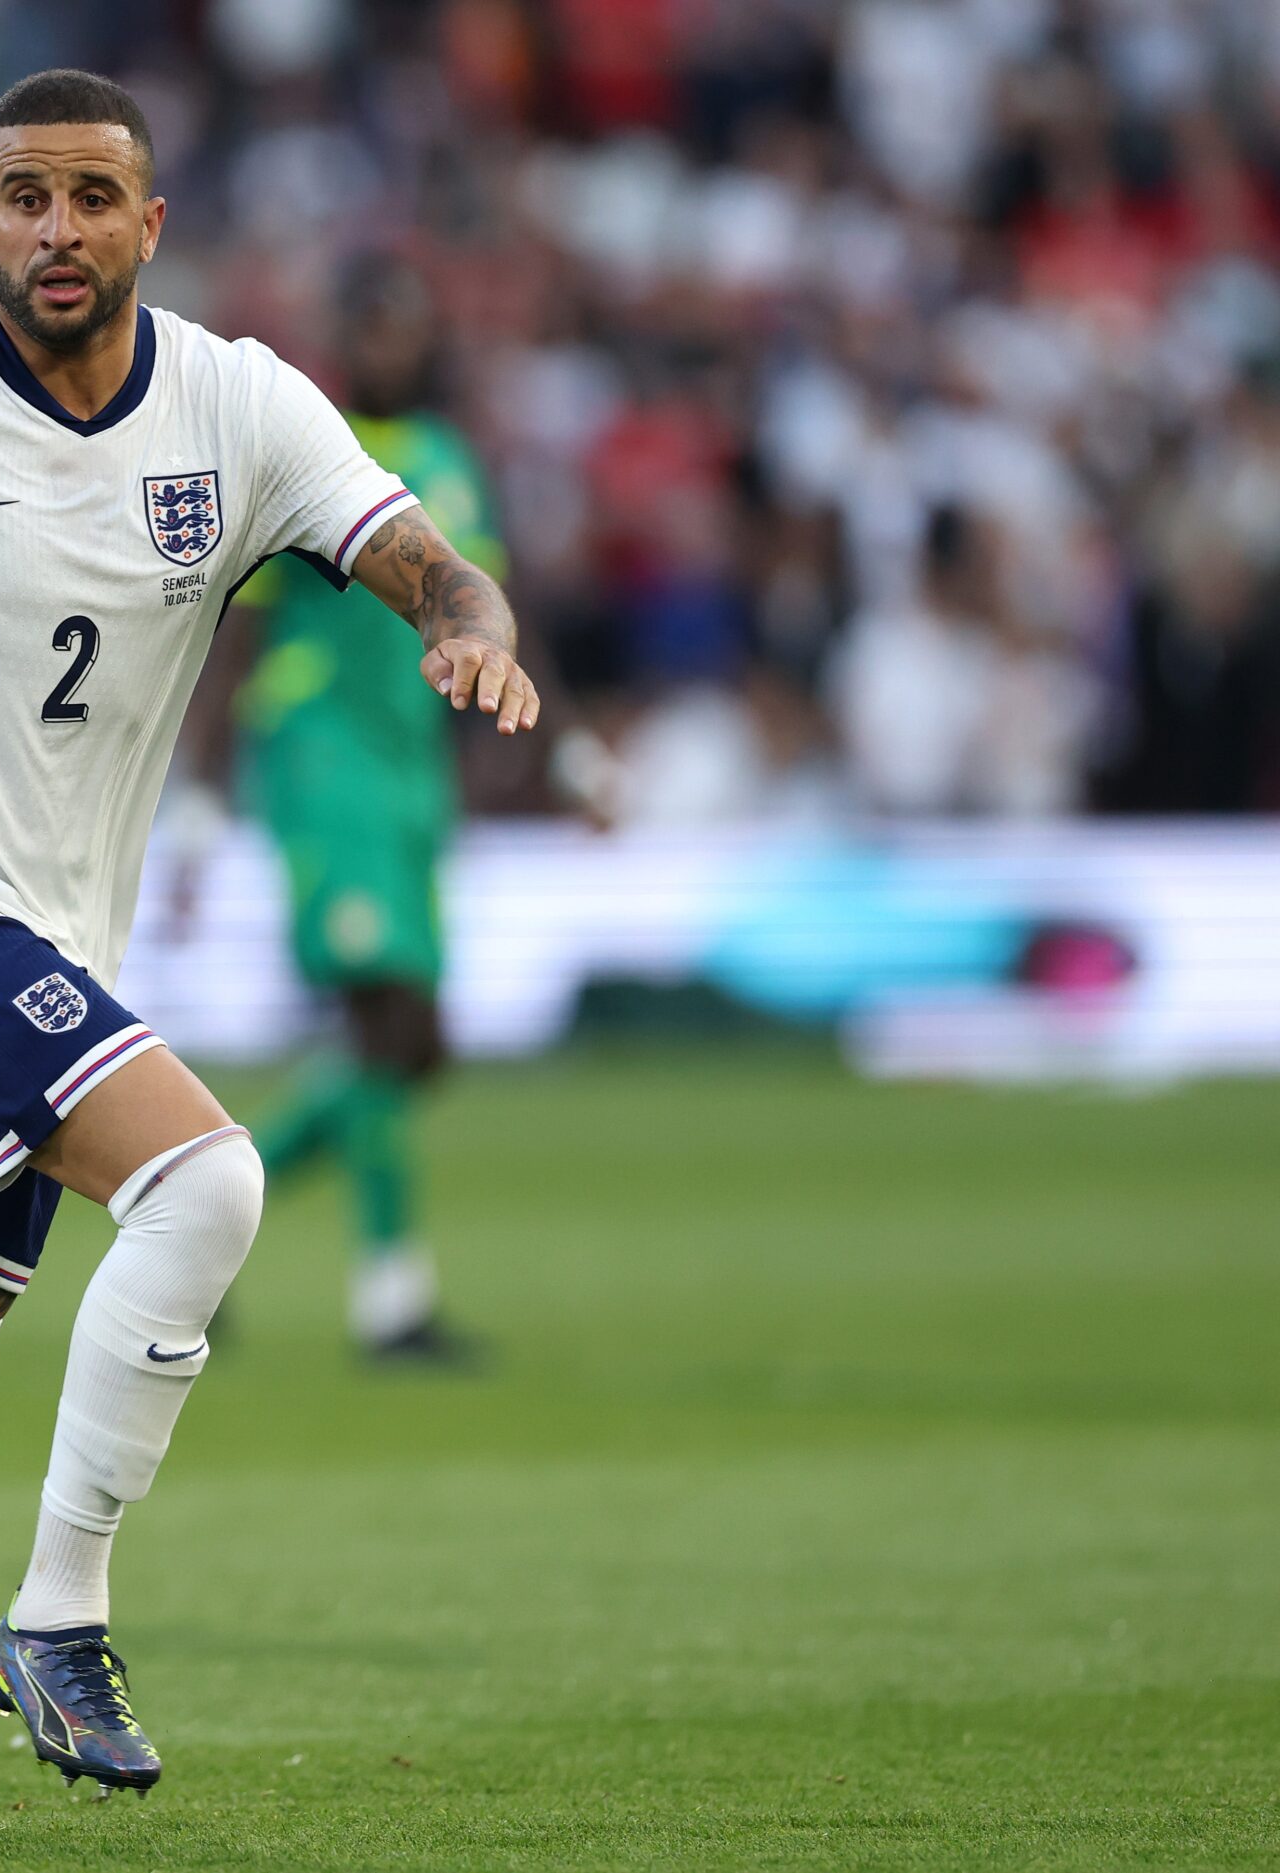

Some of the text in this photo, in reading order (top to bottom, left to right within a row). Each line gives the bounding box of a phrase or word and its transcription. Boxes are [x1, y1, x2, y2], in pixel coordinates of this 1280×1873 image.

[162, 572, 207, 591] SENEGAL
[164, 590, 202, 606] 10.06.25
[41, 615, 100, 723] 2
